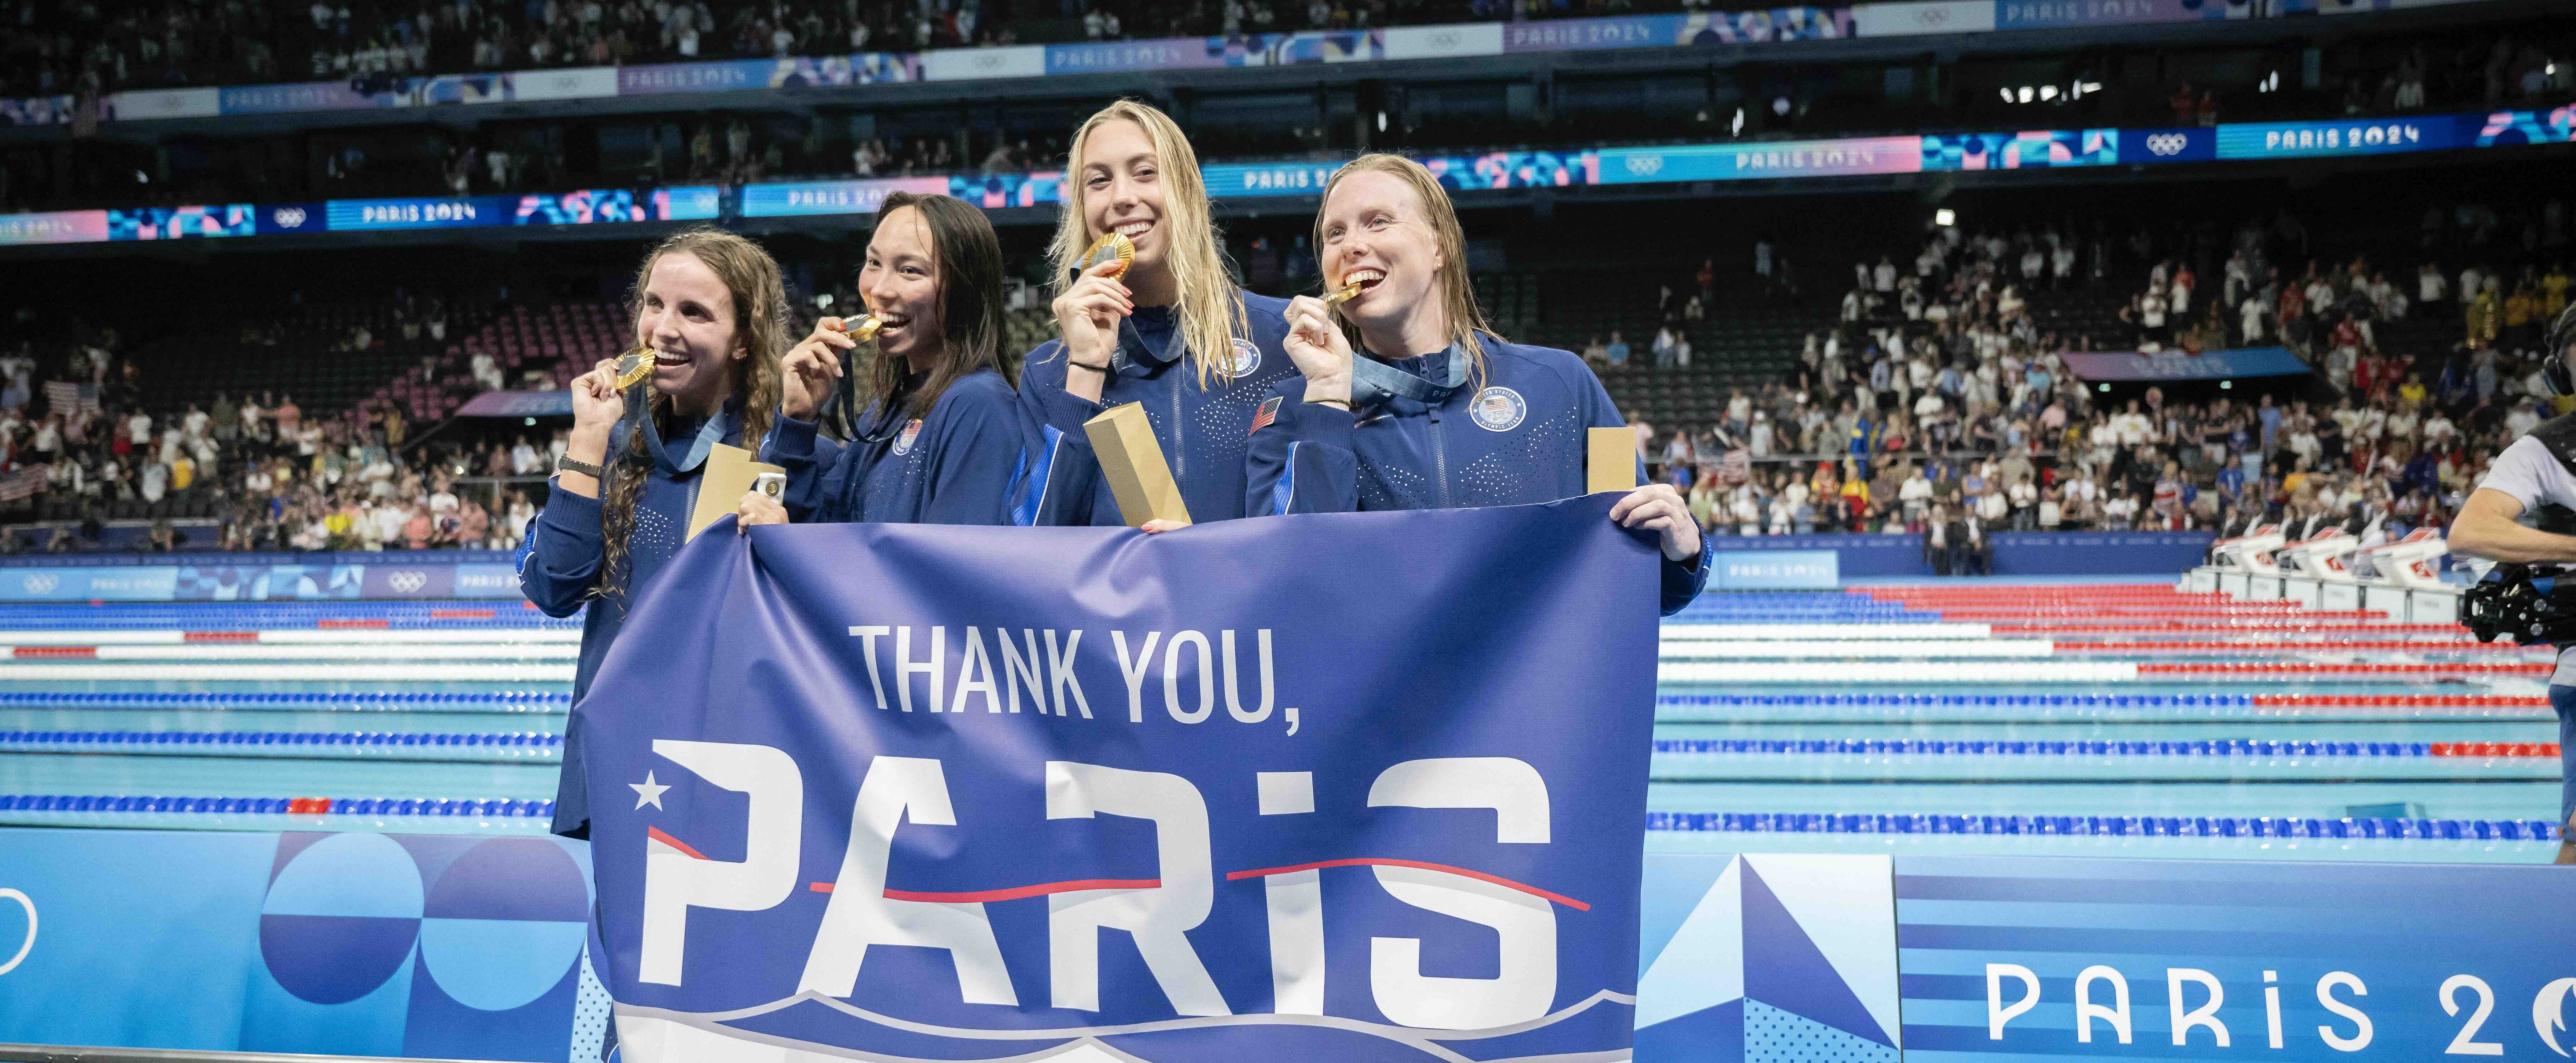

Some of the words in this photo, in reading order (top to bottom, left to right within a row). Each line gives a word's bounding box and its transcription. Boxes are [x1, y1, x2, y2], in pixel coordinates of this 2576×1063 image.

[1589, 24, 1650, 43] 2024
[2266, 128, 2339, 150] PARIS
[2349, 125, 2419, 147] 2024
[1812, 147, 1874, 167] 2024
[363, 205, 419, 223] PARIS
[424, 203, 476, 221] 2024
[1495, 390, 1515, 399] STATES
[1481, 420, 1505, 429] OLYMPIC
[1507, 416, 1520, 427] TEAM
[849, 625, 1094, 719] THANK
[1111, 629, 1299, 737] YOU,
